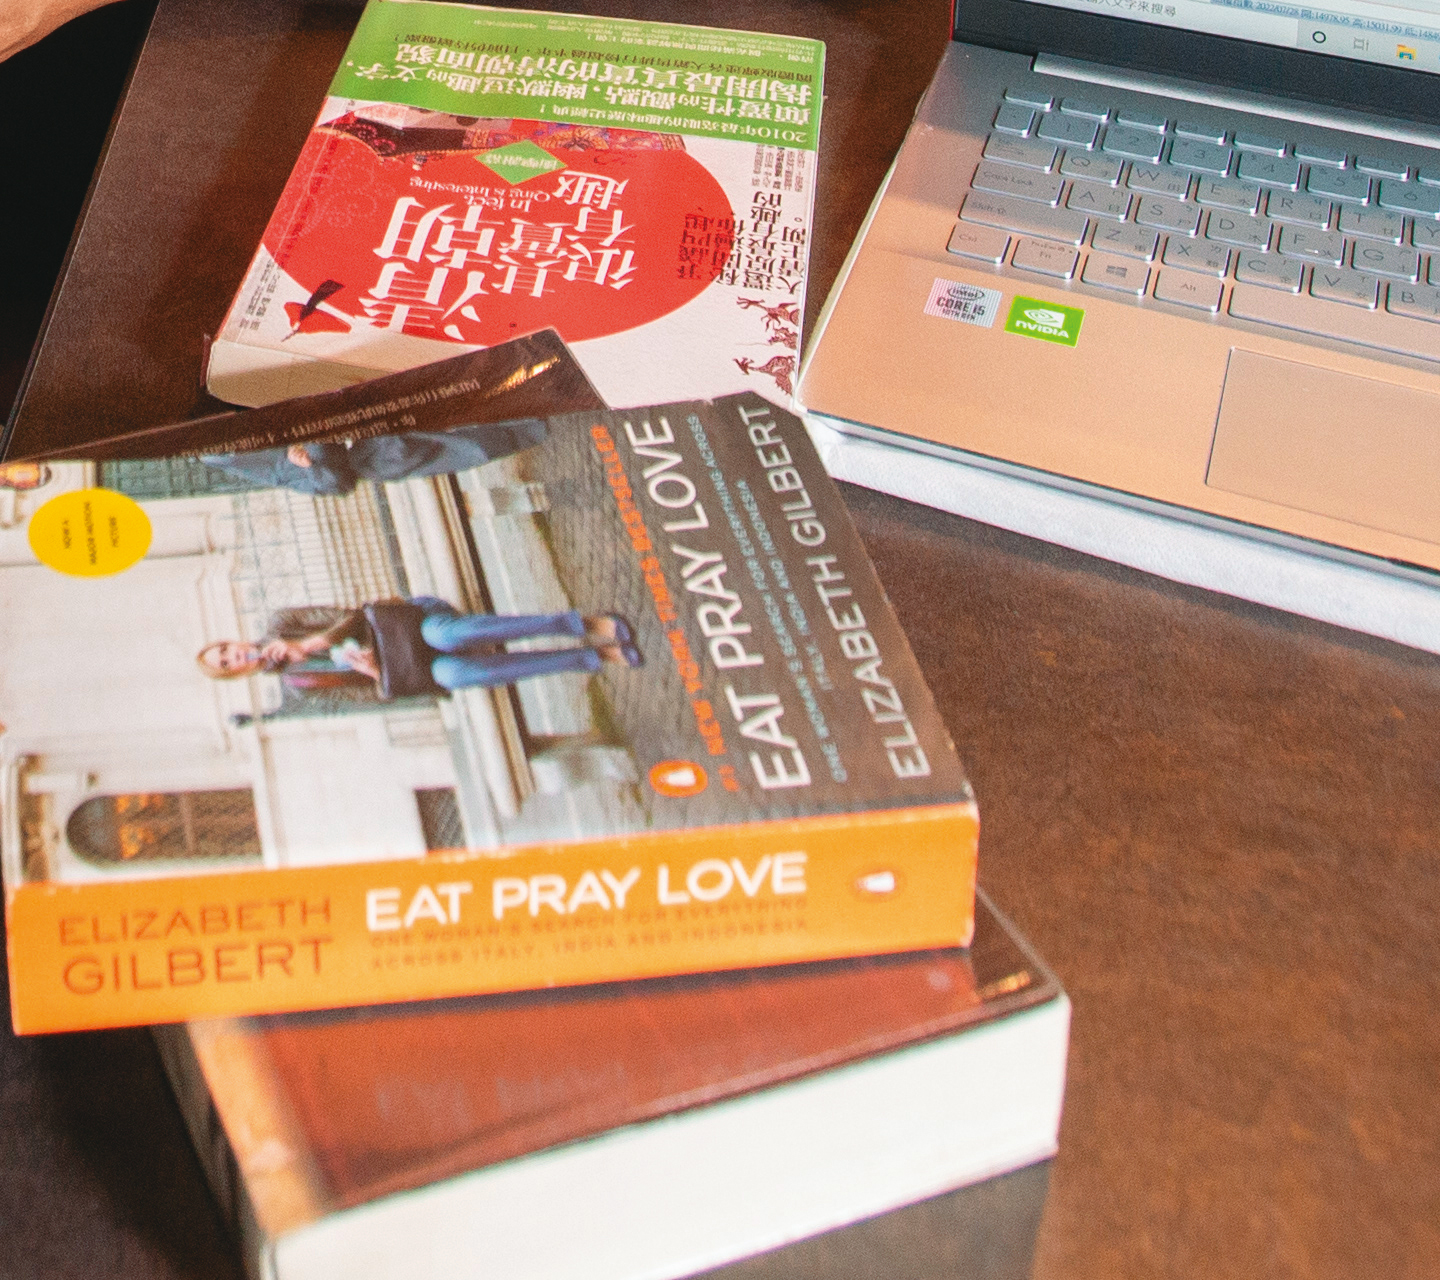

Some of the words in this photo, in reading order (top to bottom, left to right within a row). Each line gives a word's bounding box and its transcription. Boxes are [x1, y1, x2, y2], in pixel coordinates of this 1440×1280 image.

[394, 42, 813, 107] 揭開最真實的清朝面貌
[408, 175, 490, 198] Interesting
[509, 187, 551, 203] Qing
[491, 217, 574, 298] 其實
[551, 170, 638, 291] 很有趣
[744, 191, 783, 292] 還原最有趣的
[358, 195, 505, 342] 清朝
[935, 295, 972, 314] CORE
[1014, 318, 1071, 341] NVIDIA
[687, 415, 719, 468] ACROSS
[589, 424, 655, 551] BESTSELLER
[622, 417, 710, 533] LOVE
[738, 405, 828, 548] GILBERT
[710, 469, 755, 557] EVERYTHING
[737, 479, 778, 556] INDONESIA
[640, 555, 679, 623] TIMES
[747, 558, 770, 591] FOR
[771, 558, 792, 590] AND
[672, 544, 766, 671] PRAY
[761, 594, 798, 657] SEARCH
[785, 592, 811, 636] INDIA
[668, 629, 705, 694] YORK
[808, 554, 932, 780] ELIZABETH
[692, 698, 729, 757] NEW
[791, 659, 831, 738] WOMAN'S
[725, 684, 813, 790] EAT
[828, 745, 848, 783] ONE
[56, 894, 334, 949] ELIZABETH
[366, 881, 471, 931] EAT
[492, 865, 643, 922] PRAY
[658, 851, 809, 904] LOVE
[62, 938, 334, 999] GILBERT
